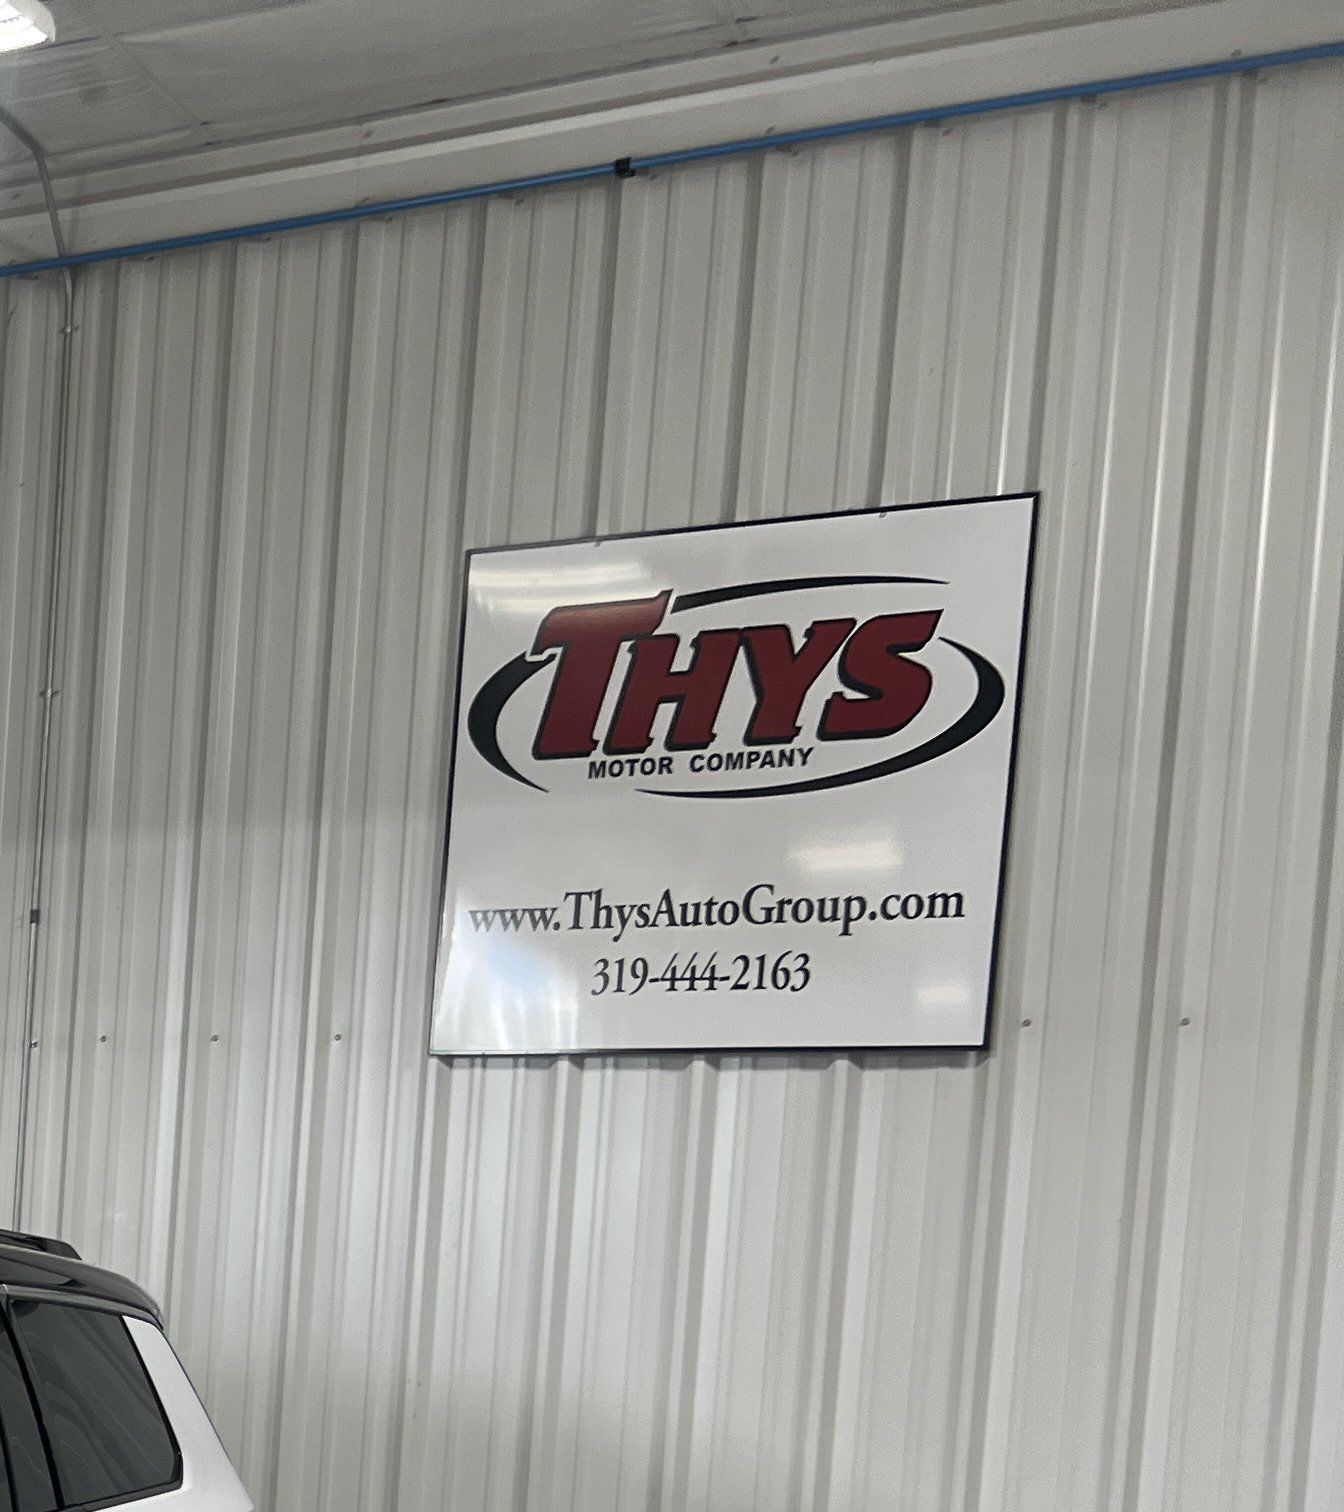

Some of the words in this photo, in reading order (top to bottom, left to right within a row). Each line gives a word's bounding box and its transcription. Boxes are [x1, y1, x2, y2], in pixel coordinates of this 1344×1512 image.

[587, 755, 673, 779] MOTOR
[689, 748, 814, 773] COMPANY
[468, 885, 965, 942] www.ThysAutoGroup.com
[592, 951, 811, 996] 319-444-2163
